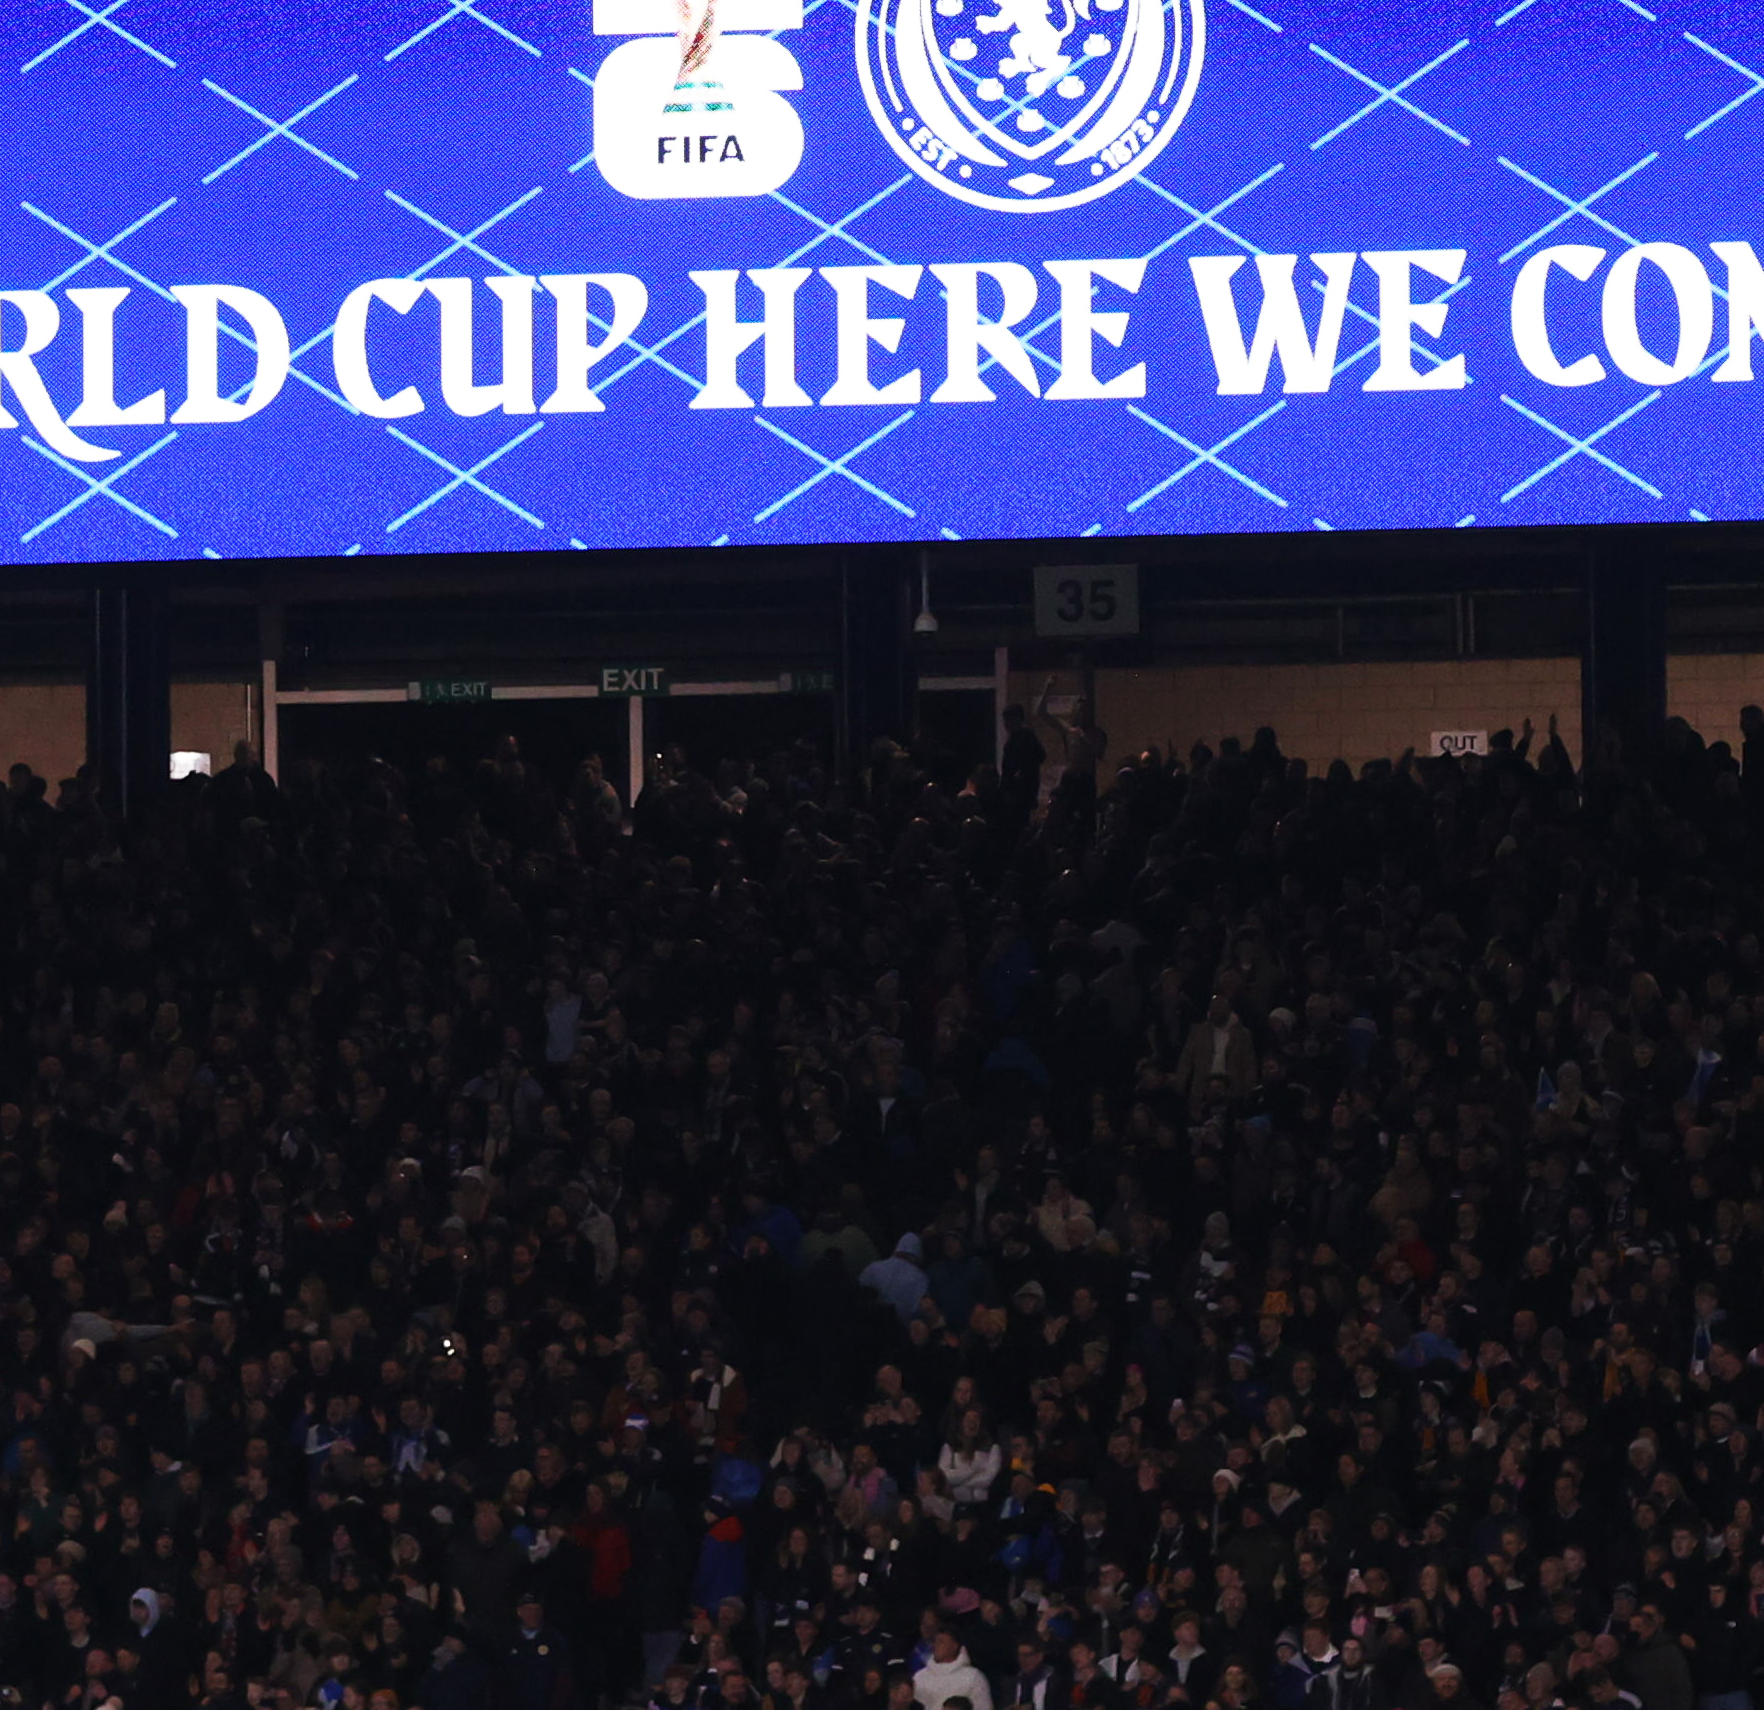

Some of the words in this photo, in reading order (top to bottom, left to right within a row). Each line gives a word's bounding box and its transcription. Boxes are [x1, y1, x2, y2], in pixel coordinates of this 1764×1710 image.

[657, 134, 745, 165] FIFA
[909, 125, 959, 172] EST
[1100, 117, 1155, 171] 1873
[332, 272, 649, 420] CUP
[686, 256, 1149, 411] HERE
[1188, 248, 1467, 396] WE
[1057, 579, 1116, 622] 35
[450, 681, 487, 698] EXIT
[602, 668, 665, 692] EXIT
[1440, 735, 1477, 750] OUT
